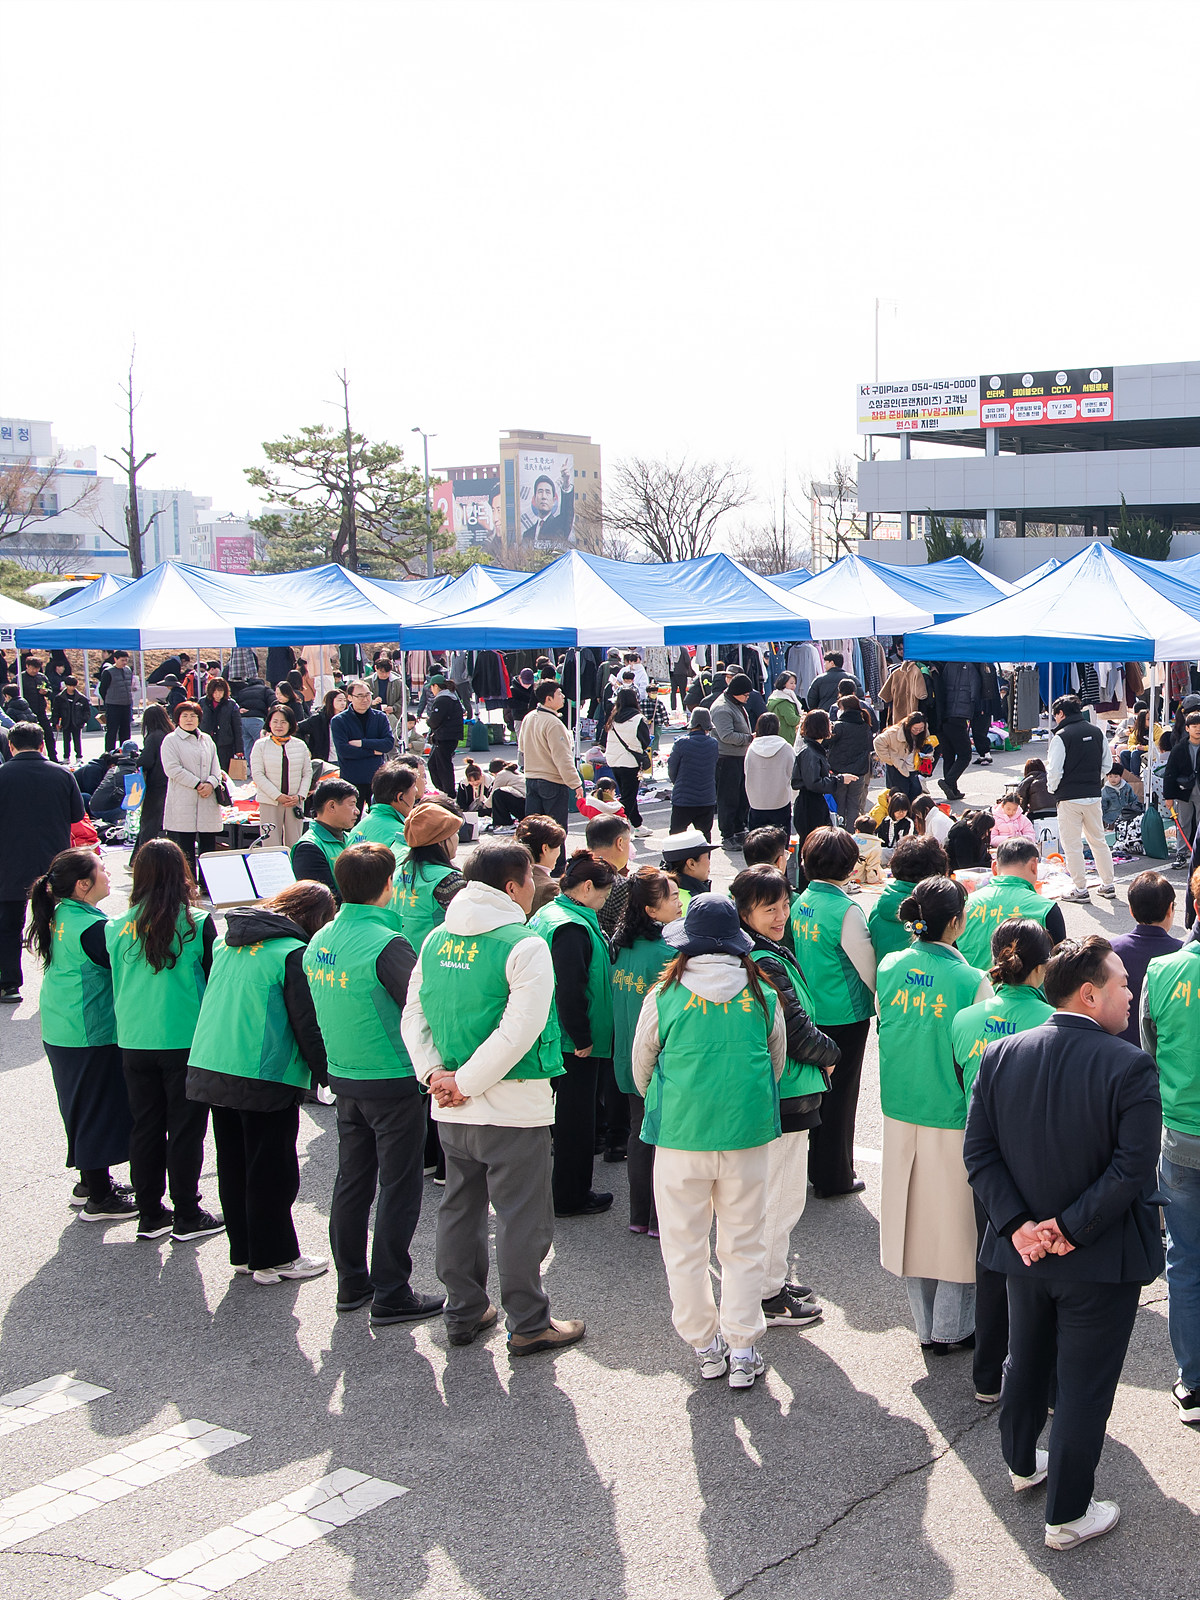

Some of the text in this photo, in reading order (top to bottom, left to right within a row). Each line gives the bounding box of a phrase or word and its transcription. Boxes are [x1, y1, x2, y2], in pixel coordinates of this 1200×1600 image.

[860, 379, 976, 396] kt 구미Plaza 054-454-0000
[1051, 386, 1071, 394] CCTV
[868, 394, 967, 409] 소상공인(프랜차이즈) 고객님
[872, 406, 964, 420] 창업 준비에서 TV광고까지
[896, 419, 939, 430] 원스톱 지원!
[798, 906, 814, 917] SMU
[437, 939, 479, 962] 새마을
[316, 952, 336, 965] SMU
[440, 960, 470, 970] SAEMAUL
[612, 969, 647, 994] 새마을
[906, 971, 935, 987] SMU
[891, 989, 947, 1018] 새마을
[984, 1019, 1016, 1034] SMU
